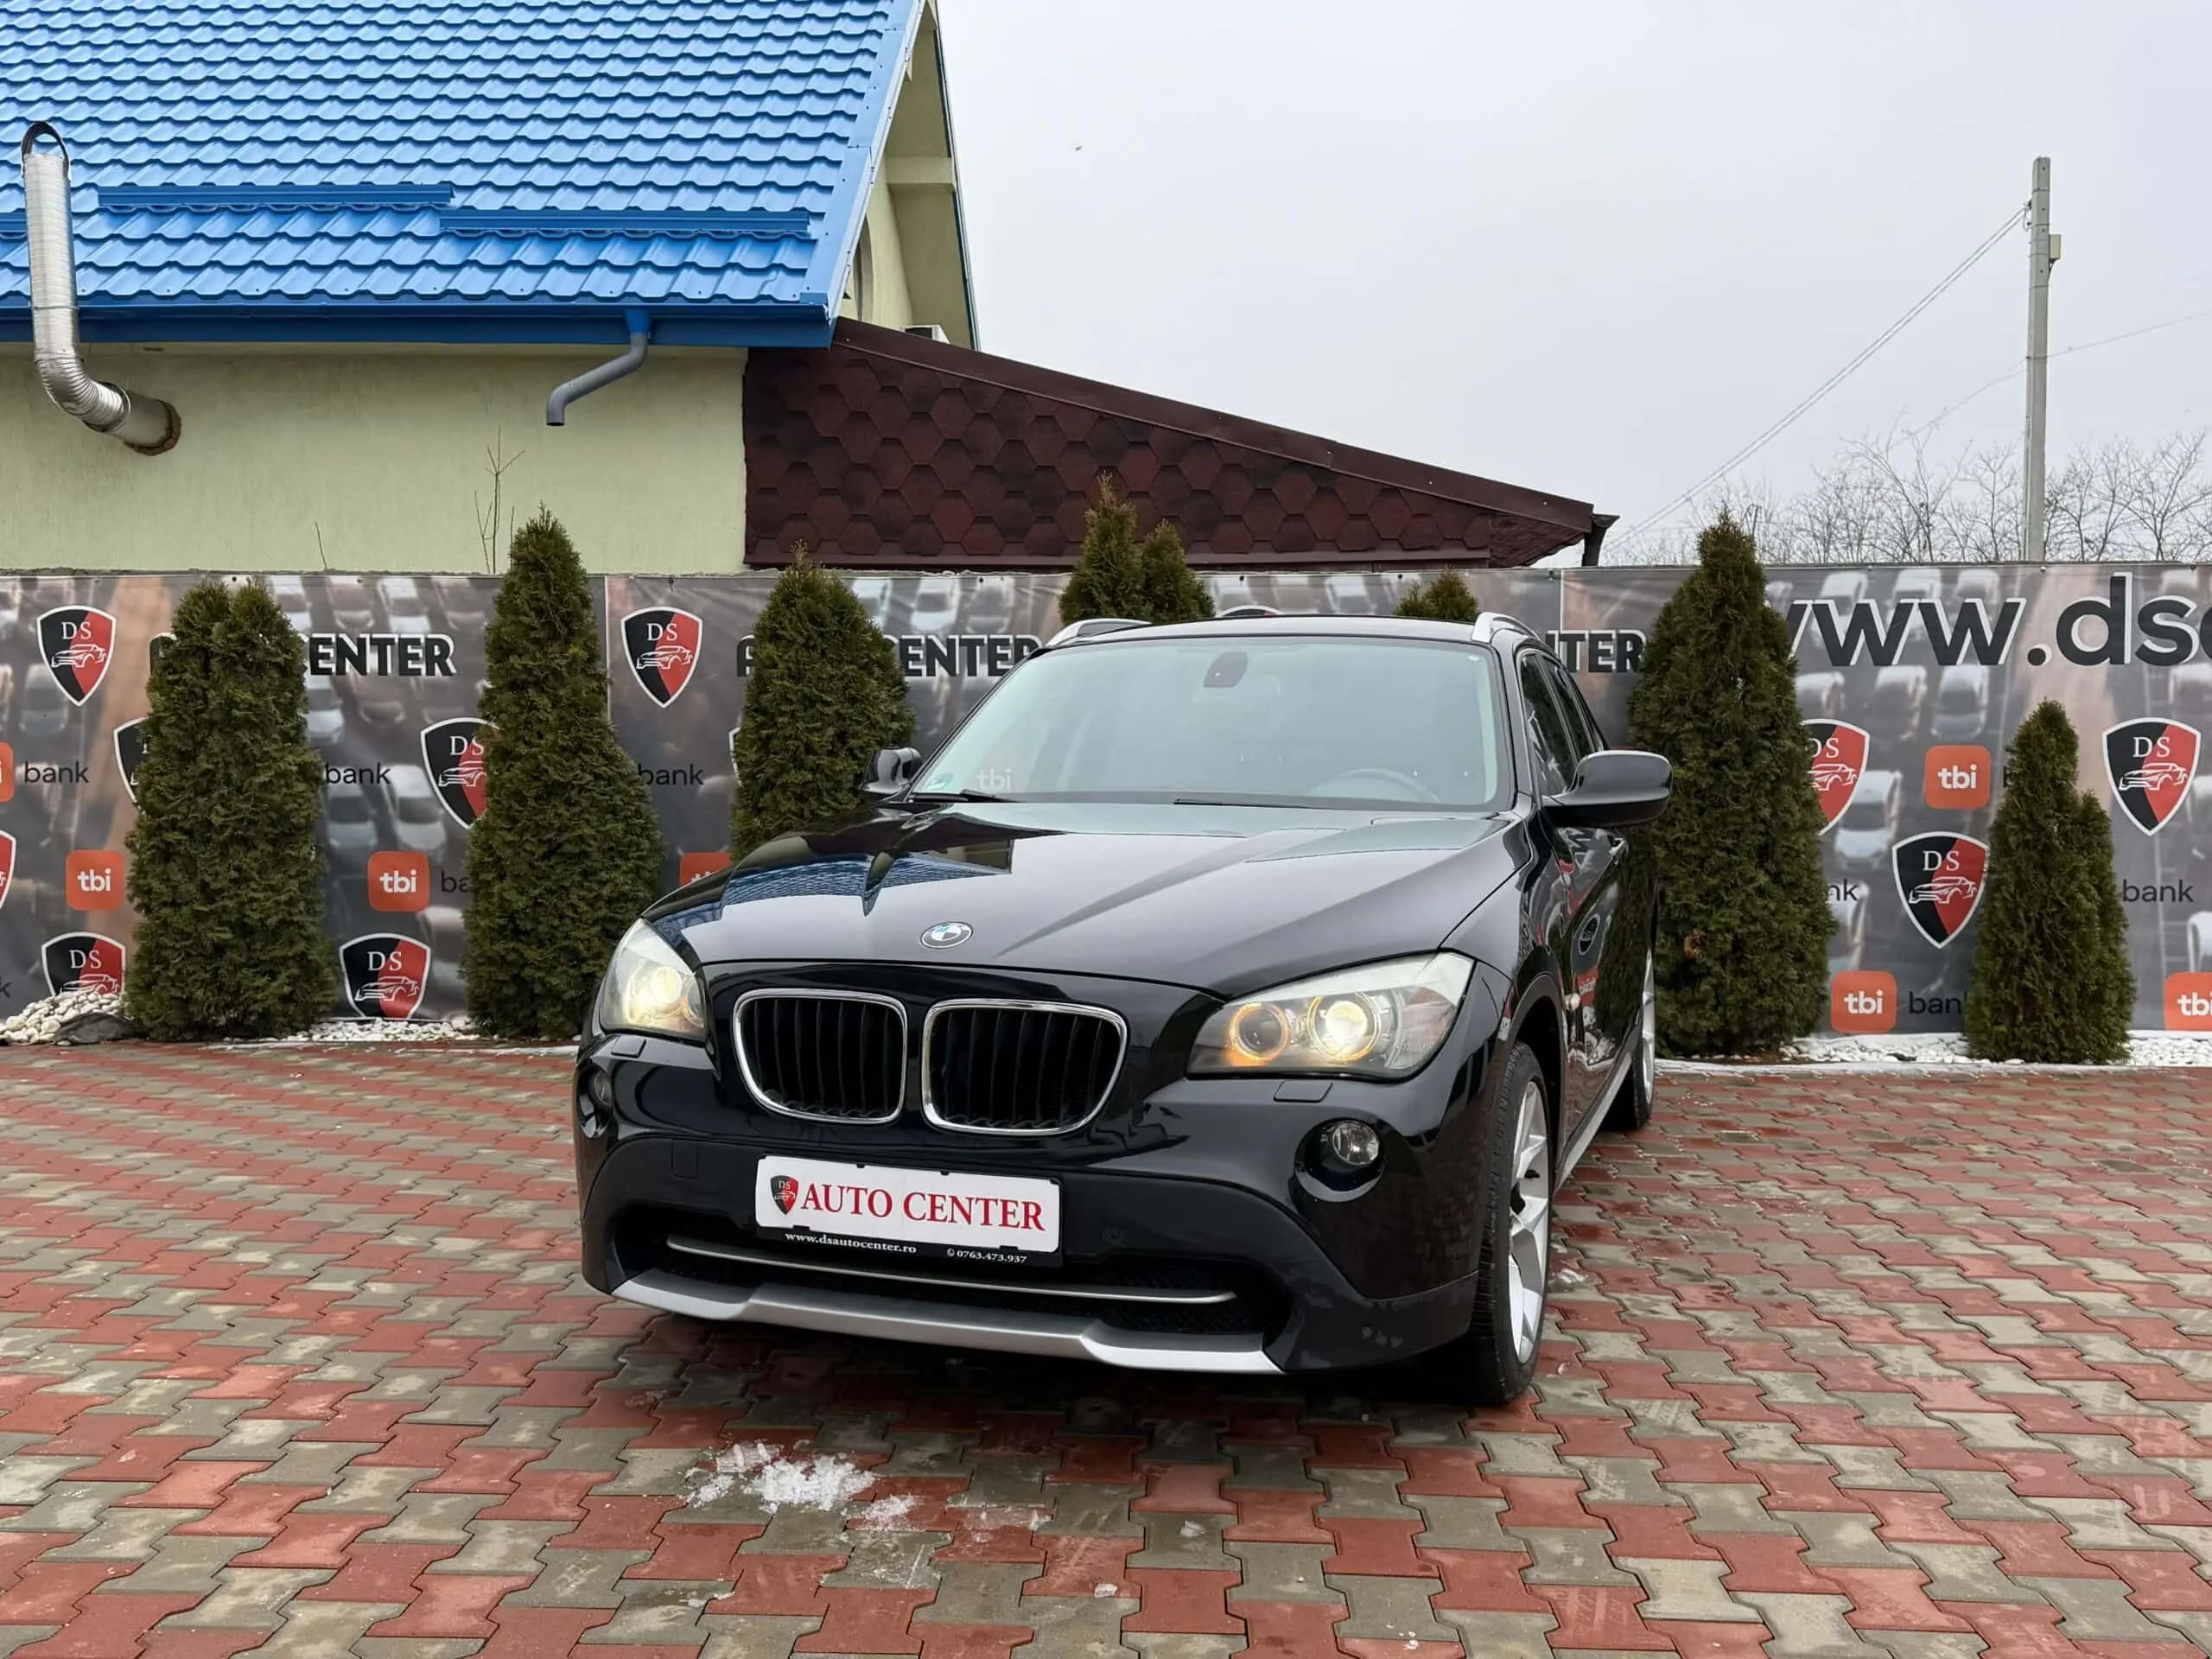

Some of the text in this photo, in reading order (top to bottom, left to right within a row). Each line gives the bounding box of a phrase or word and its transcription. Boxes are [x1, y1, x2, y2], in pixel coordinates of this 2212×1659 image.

[1785, 572, 2212, 666] ww.ds
[61, 621, 92, 640] DS
[647, 623, 678, 641] DS
[2133, 735, 2171, 759] DS
[24, 761, 89, 783] bank
[326, 762, 391, 784] bank
[638, 763, 704, 785] bank
[1938, 764, 1977, 790] tbi
[1923, 850, 1960, 871] DS
[78, 868, 111, 893] tbi
[380, 869, 471, 893] tbi ba
[2122, 880, 2194, 903] bank
[69, 950, 102, 969] DS
[367, 950, 402, 971] DS
[1844, 989, 1967, 1014] tbi ban
[800, 1183, 1046, 1230] AUTO CENTER
[785, 1232, 917, 1254] www.dsautocenter.ro
[957, 1249, 1027, 1264] 0763.473.937
